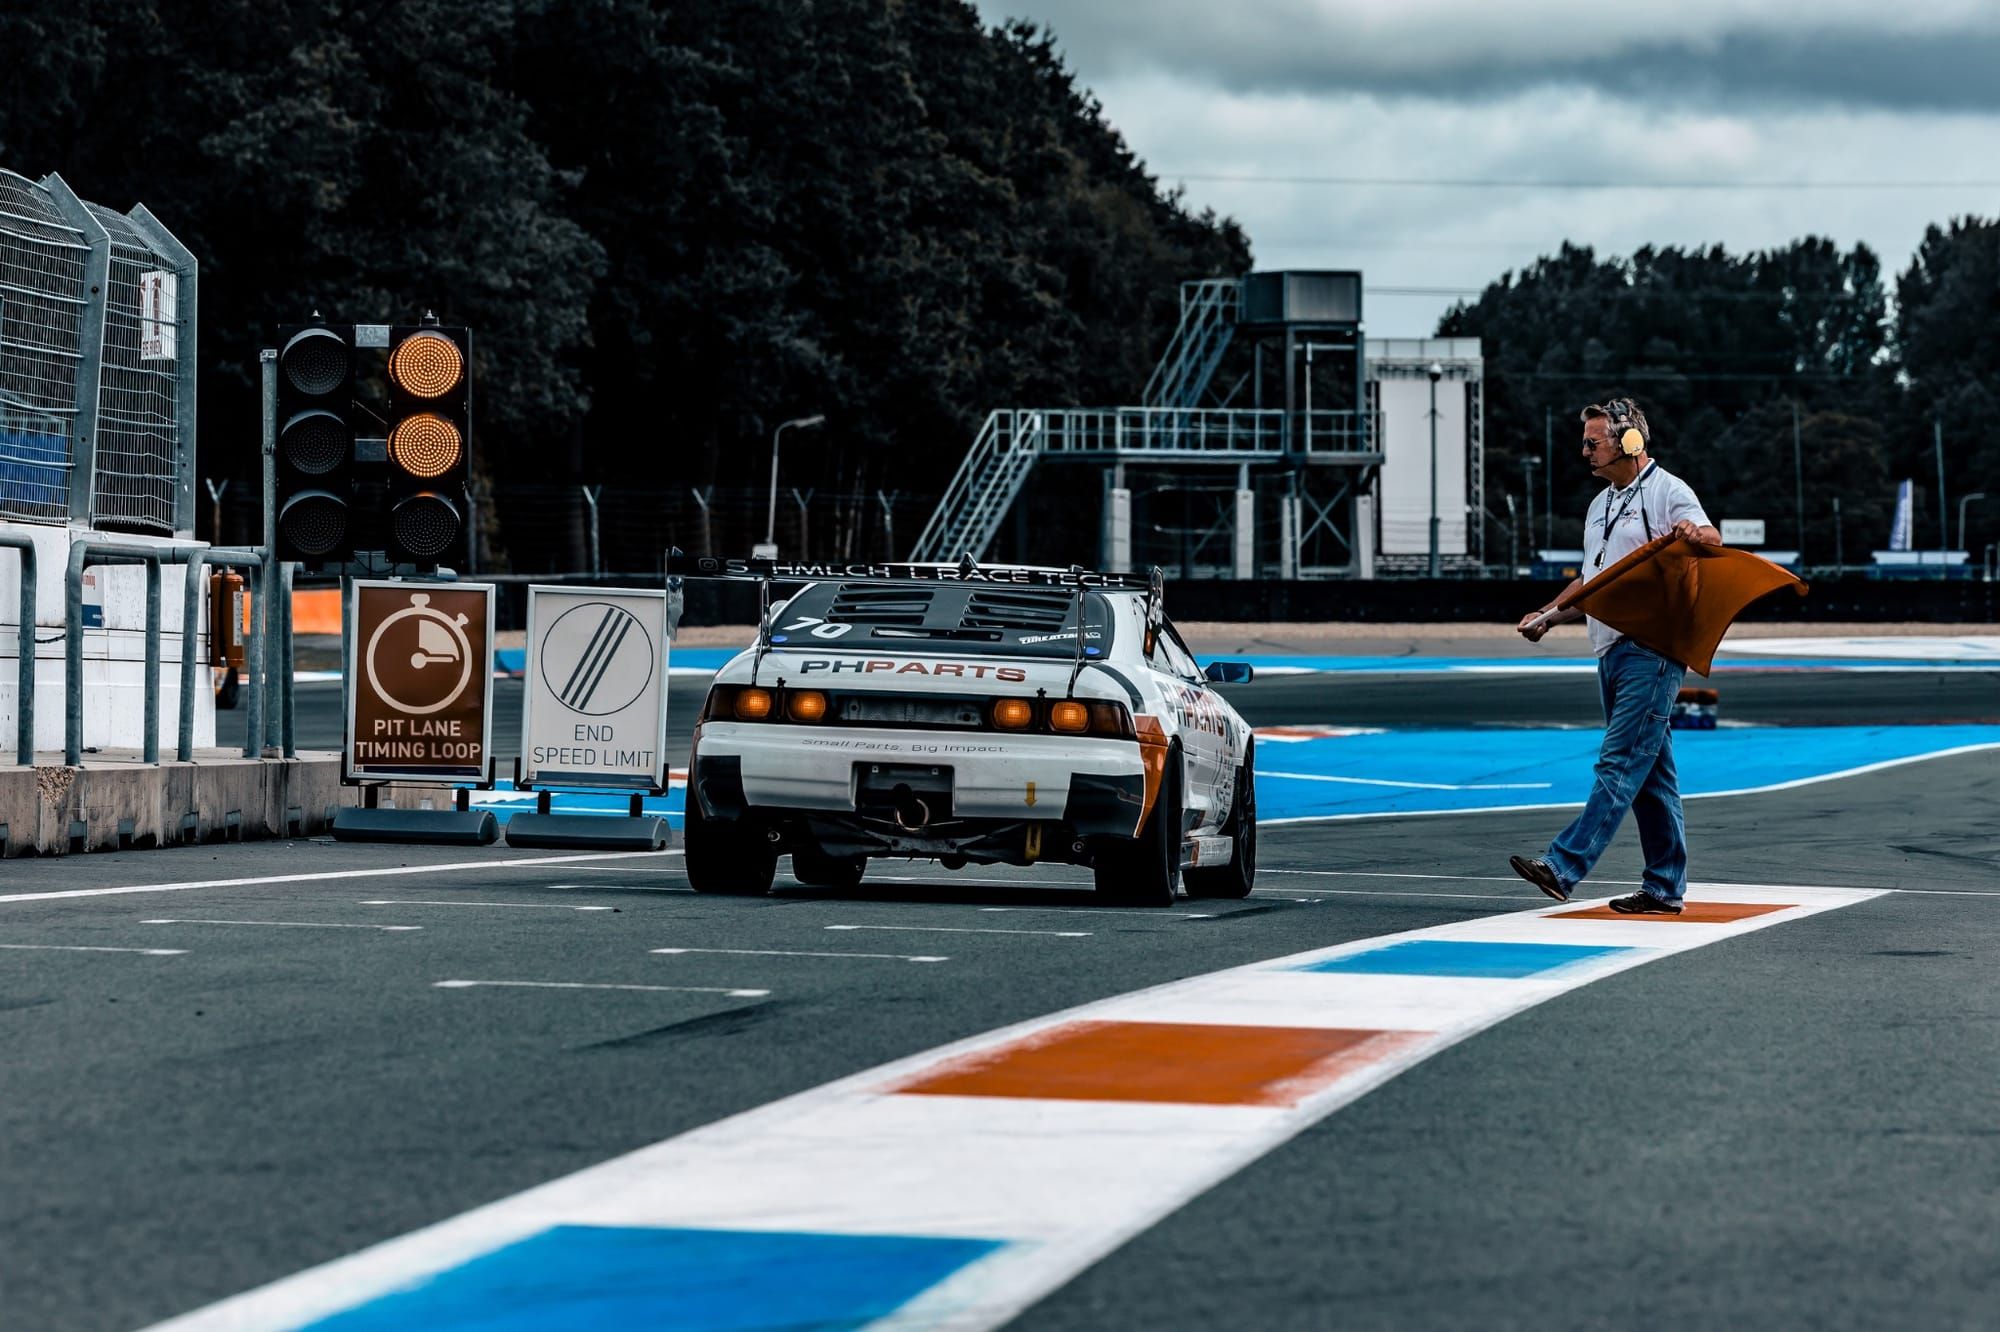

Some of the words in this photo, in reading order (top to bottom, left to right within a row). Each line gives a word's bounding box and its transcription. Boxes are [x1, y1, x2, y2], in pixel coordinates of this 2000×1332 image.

[936, 567, 1030, 584] RACE
[1038, 572, 1124, 588] TECH
[782, 616, 853, 639] 70
[800, 661, 1027, 682] PHPARTS
[374, 719, 404, 737] PIT
[409, 720, 462, 737] LANE
[574, 724, 614, 742] END
[356, 741, 426, 759] TIMING
[430, 743, 481, 760] LOOP
[801, 738, 850, 748] Small
[855, 741, 903, 751] Parts.
[911, 744, 938, 754] Big
[944, 744, 1009, 754] Impact.
[532, 746, 597, 766] SPEED
[602, 749, 654, 768] LIMIT
